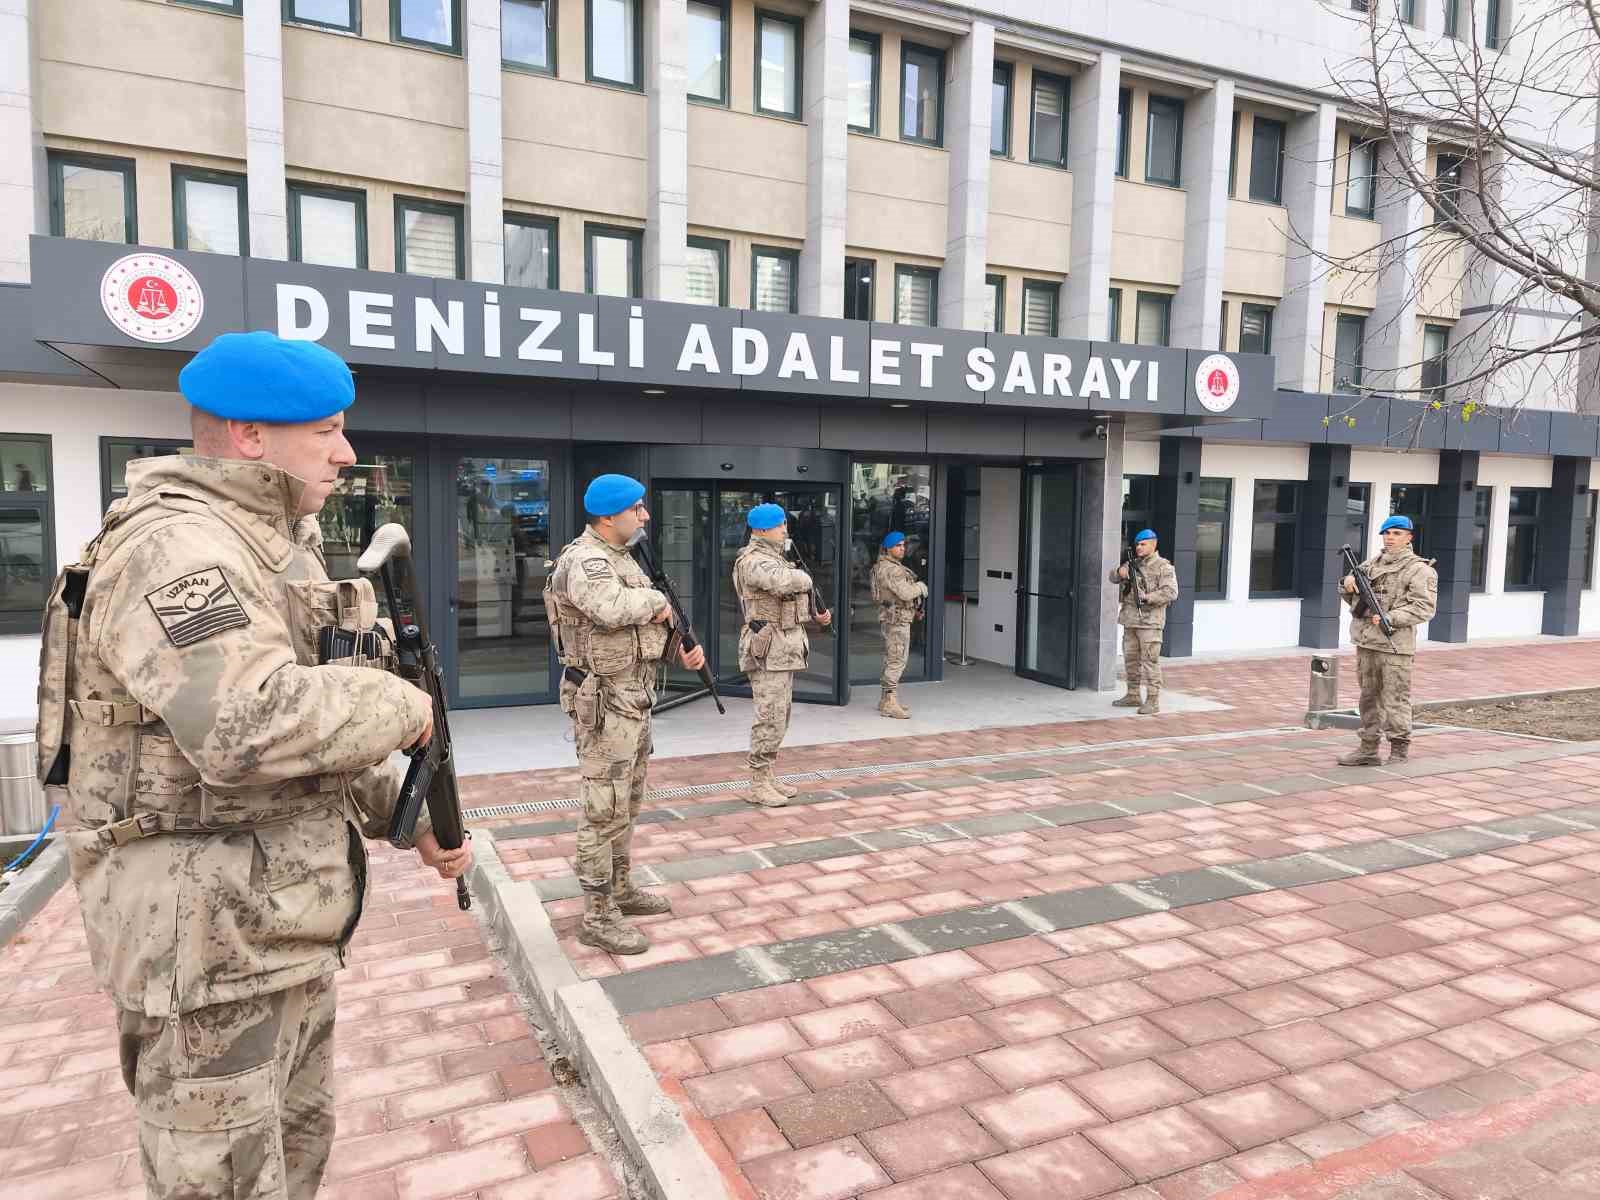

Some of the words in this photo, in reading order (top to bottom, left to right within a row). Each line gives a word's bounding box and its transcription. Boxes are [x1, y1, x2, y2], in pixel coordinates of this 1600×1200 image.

[276, 283, 645, 368] DENİZLİ
[677, 323, 944, 389] ADALET
[965, 347, 1160, 402] SARAYI
[166, 578, 209, 599] UZMAN
